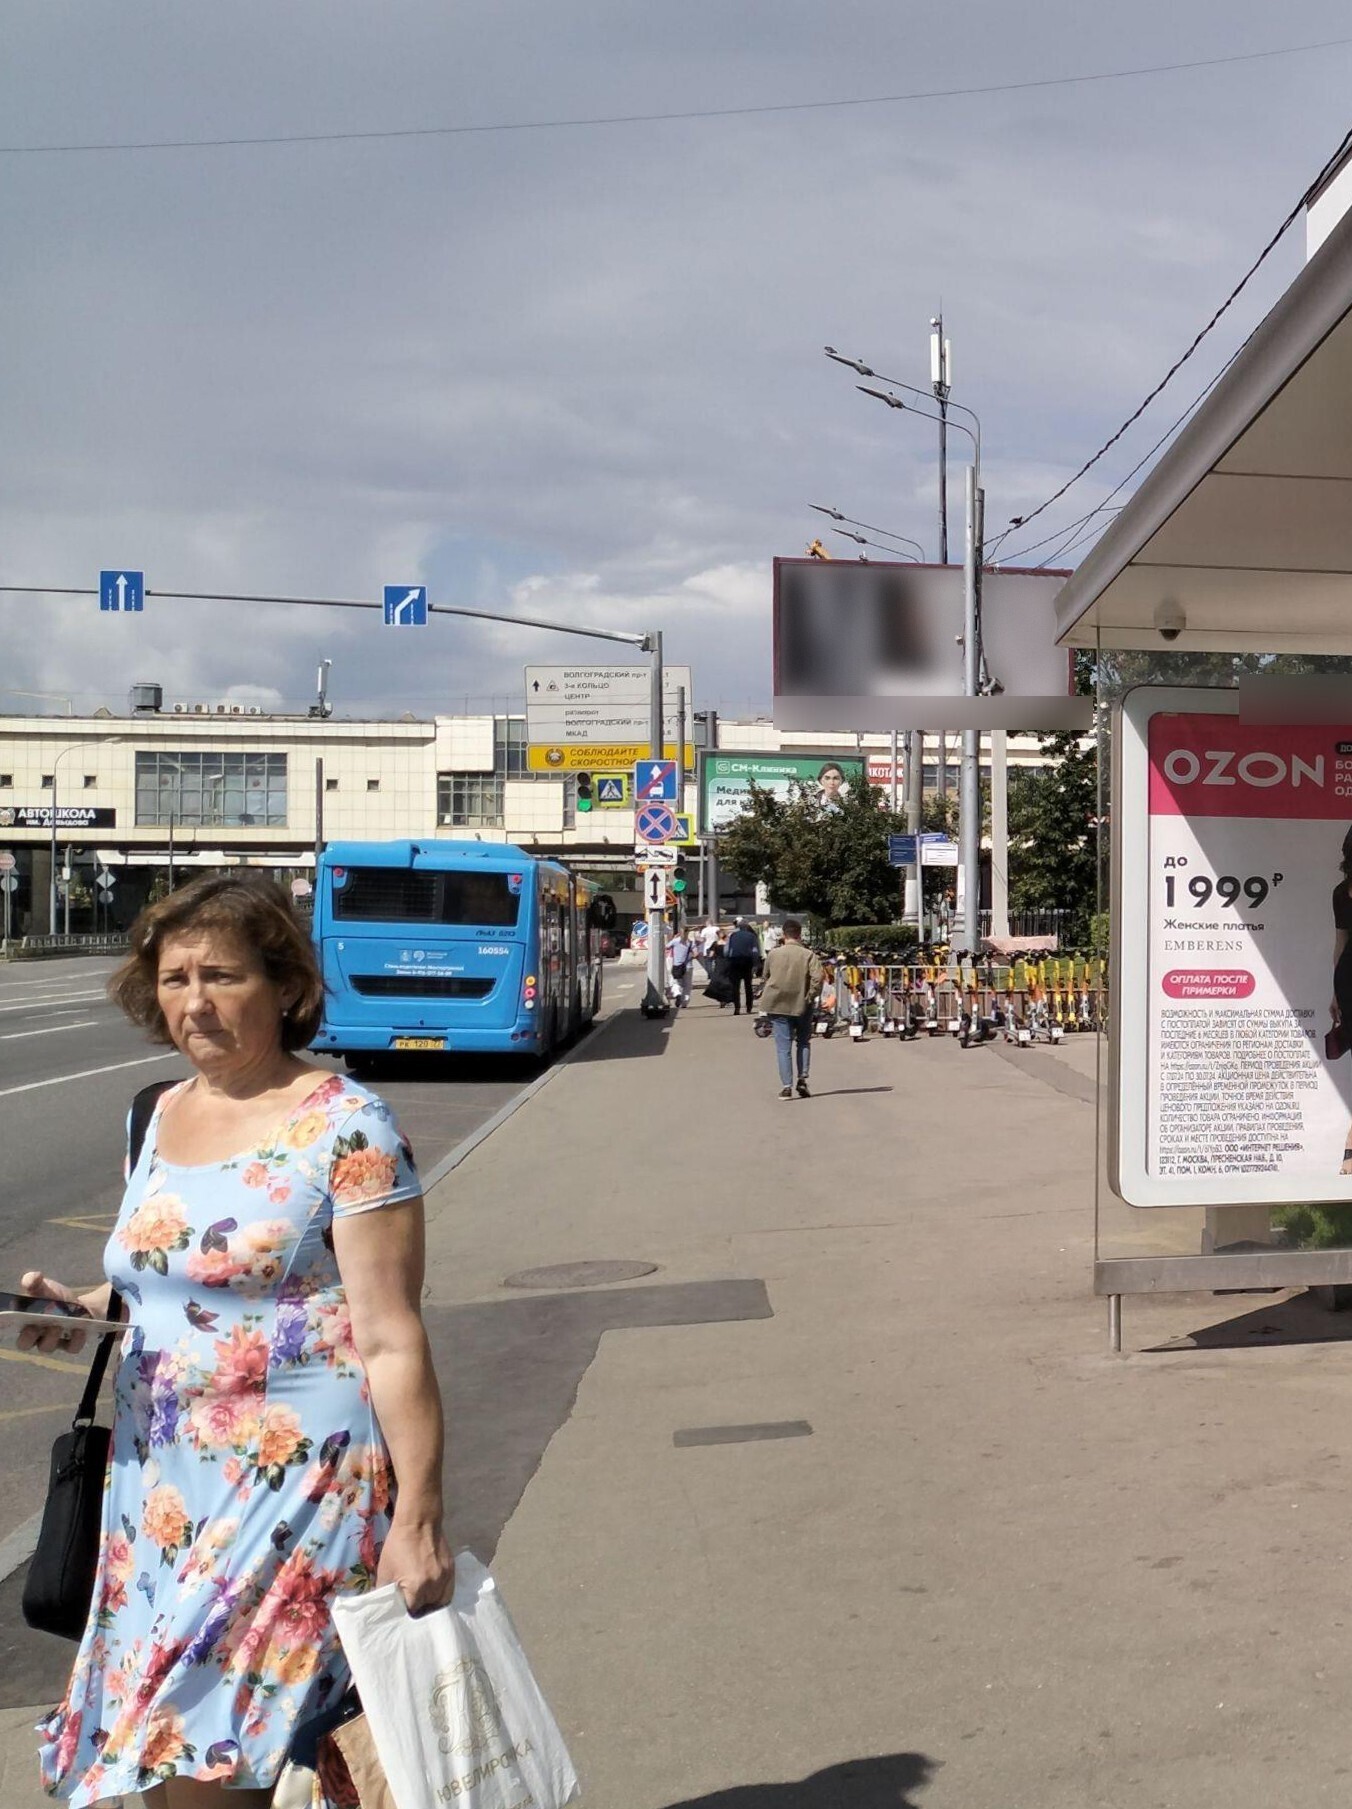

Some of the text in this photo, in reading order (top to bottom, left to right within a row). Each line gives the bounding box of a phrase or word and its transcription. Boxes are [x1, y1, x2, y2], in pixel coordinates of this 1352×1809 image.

[564, 671, 630, 679] ВОЛГОГРАДСКИЙ
[577, 682, 610, 690] КОЛЬЦО
[564, 693, 591, 701] ЦЕНТР
[570, 747, 640, 757] СОБЛЮДАЙТЕ
[731, 763, 798, 774] СМ-Клиника
[1163, 748, 1326, 788] OZON
[18, 808, 97, 819] АВТОШКОЛА
[1163, 856, 1188, 869] до
[1163, 918, 1265, 931] Женские платья
[338, 942, 344, 950] 5
[478, 946, 509, 955] 160554
[1164, 940, 1243, 951] EMBERENS
[1169, 975, 1249, 984] ОПЛАТА ПОСЛЕ
[1181, 986, 1238, 996] ПРИМЕРКИ
[1225, 1144, 1238, 1152] ООО
